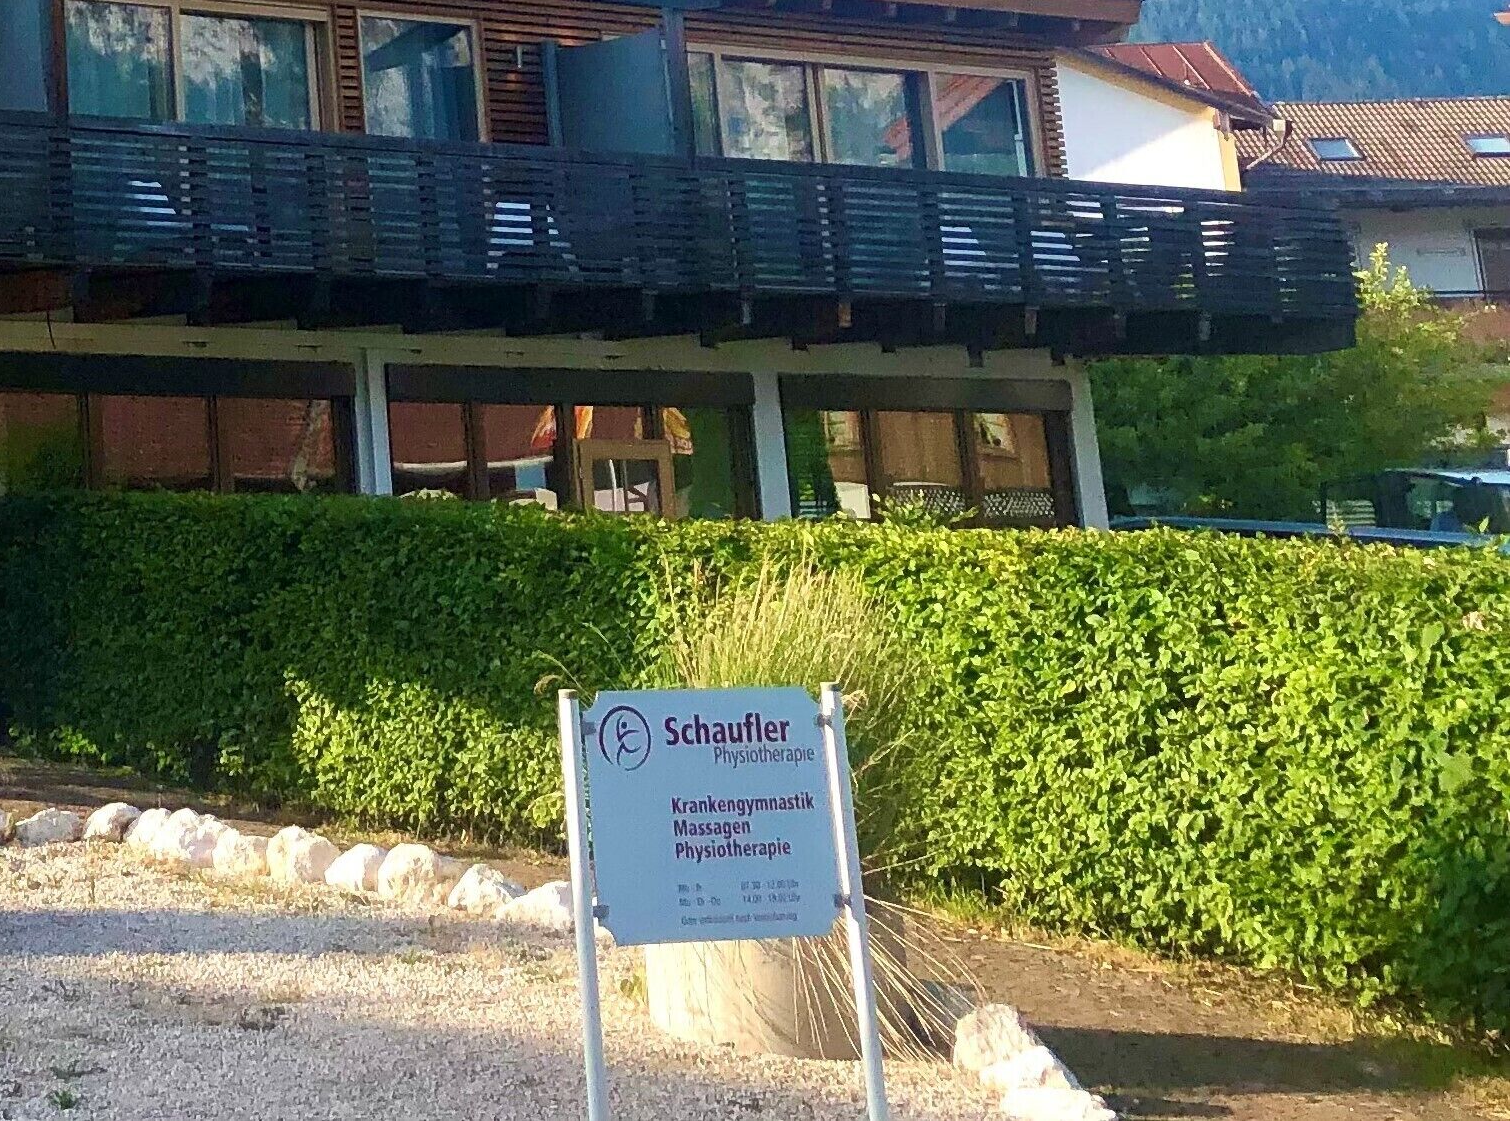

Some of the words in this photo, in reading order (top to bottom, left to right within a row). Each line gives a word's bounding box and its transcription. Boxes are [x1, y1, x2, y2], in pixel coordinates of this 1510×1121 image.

[664, 712, 790, 746] Schaufler
[713, 743, 815, 769] Physiotherapie
[671, 791, 815, 817] Krankengymnastik
[673, 818, 751, 840] Massagen
[675, 837, 792, 863] Physiotherapie
